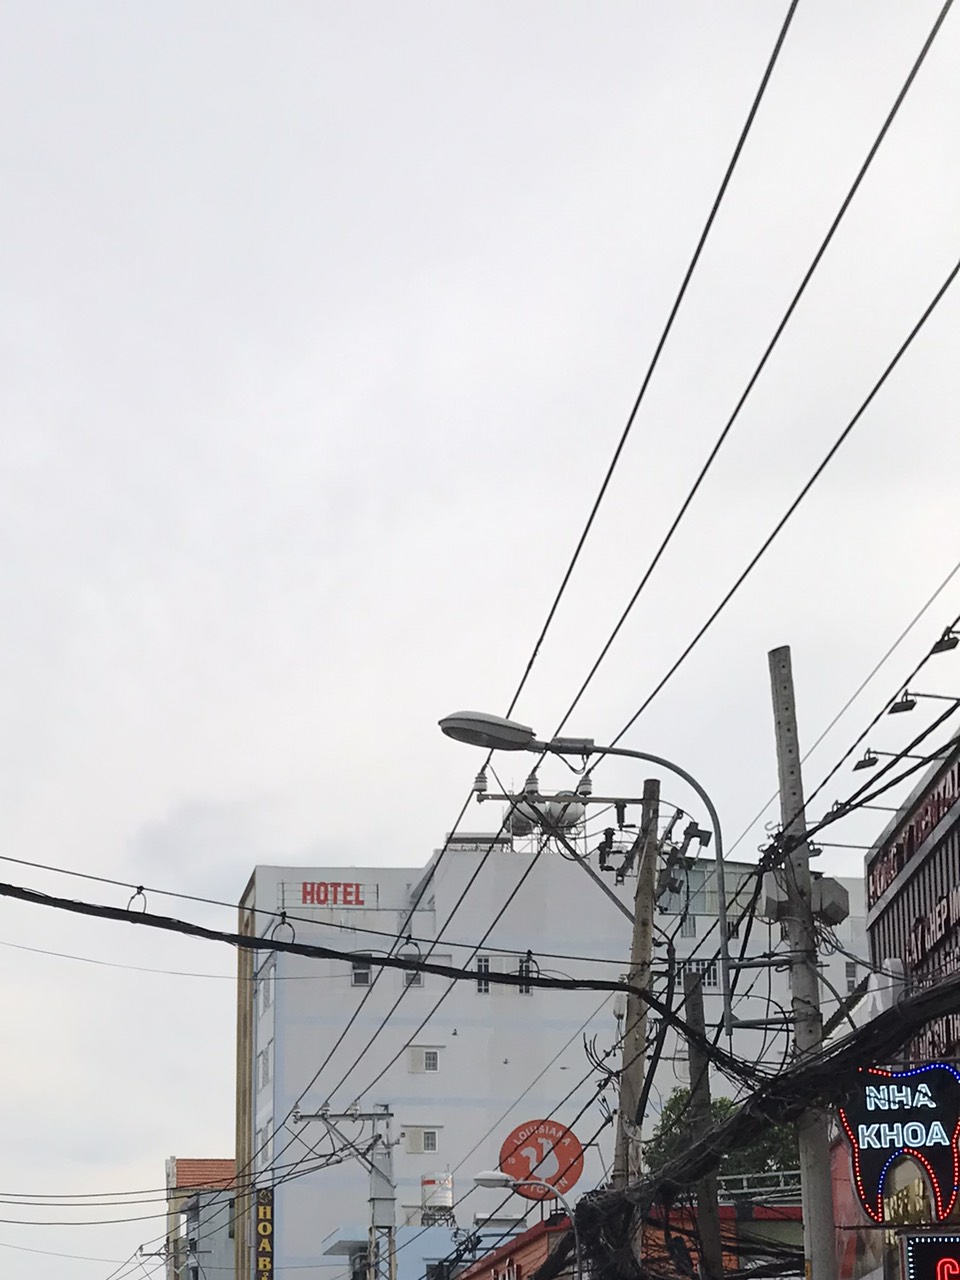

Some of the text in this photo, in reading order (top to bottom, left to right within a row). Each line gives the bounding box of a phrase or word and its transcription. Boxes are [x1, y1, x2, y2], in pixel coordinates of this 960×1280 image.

[302, 881, 364, 905] HOTEL
[865, 1083, 937, 1111] NHA
[858, 1121, 950, 1149] KHOA
